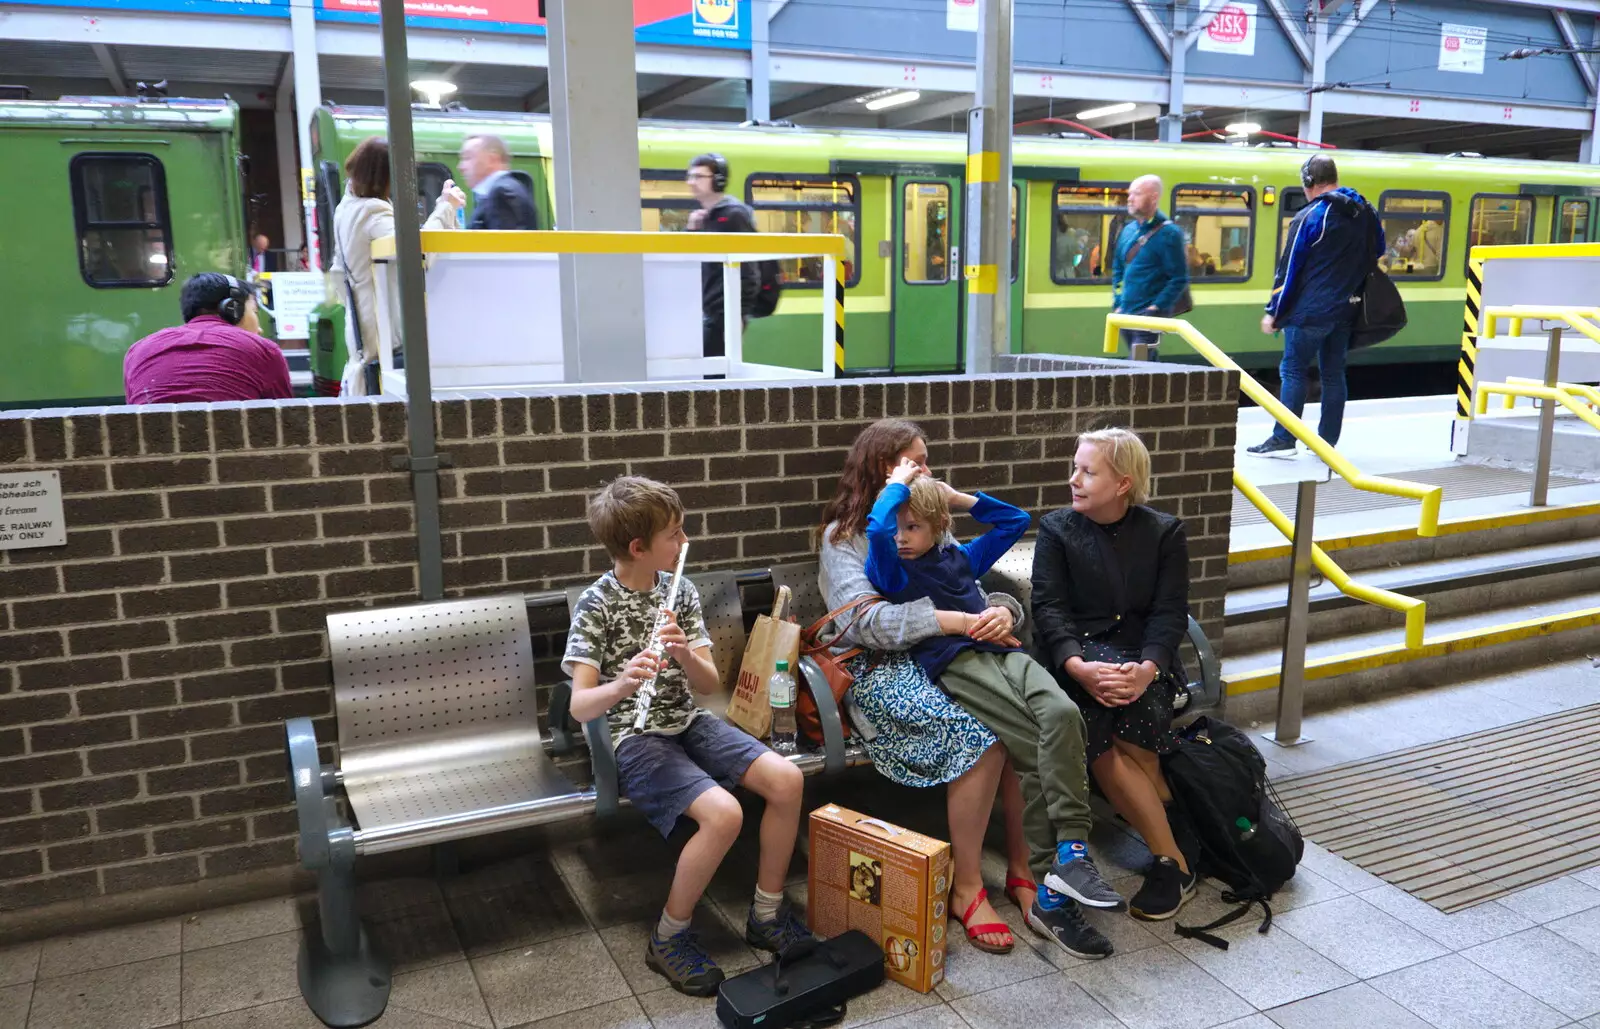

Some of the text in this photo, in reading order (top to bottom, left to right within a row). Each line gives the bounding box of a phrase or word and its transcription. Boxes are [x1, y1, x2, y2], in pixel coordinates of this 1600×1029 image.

[1211, 14, 1244, 35] SISK
[23, 480, 41, 488] ach
[11, 521, 52, 530] RAILWAY
[19, 531, 45, 540] ONLY
